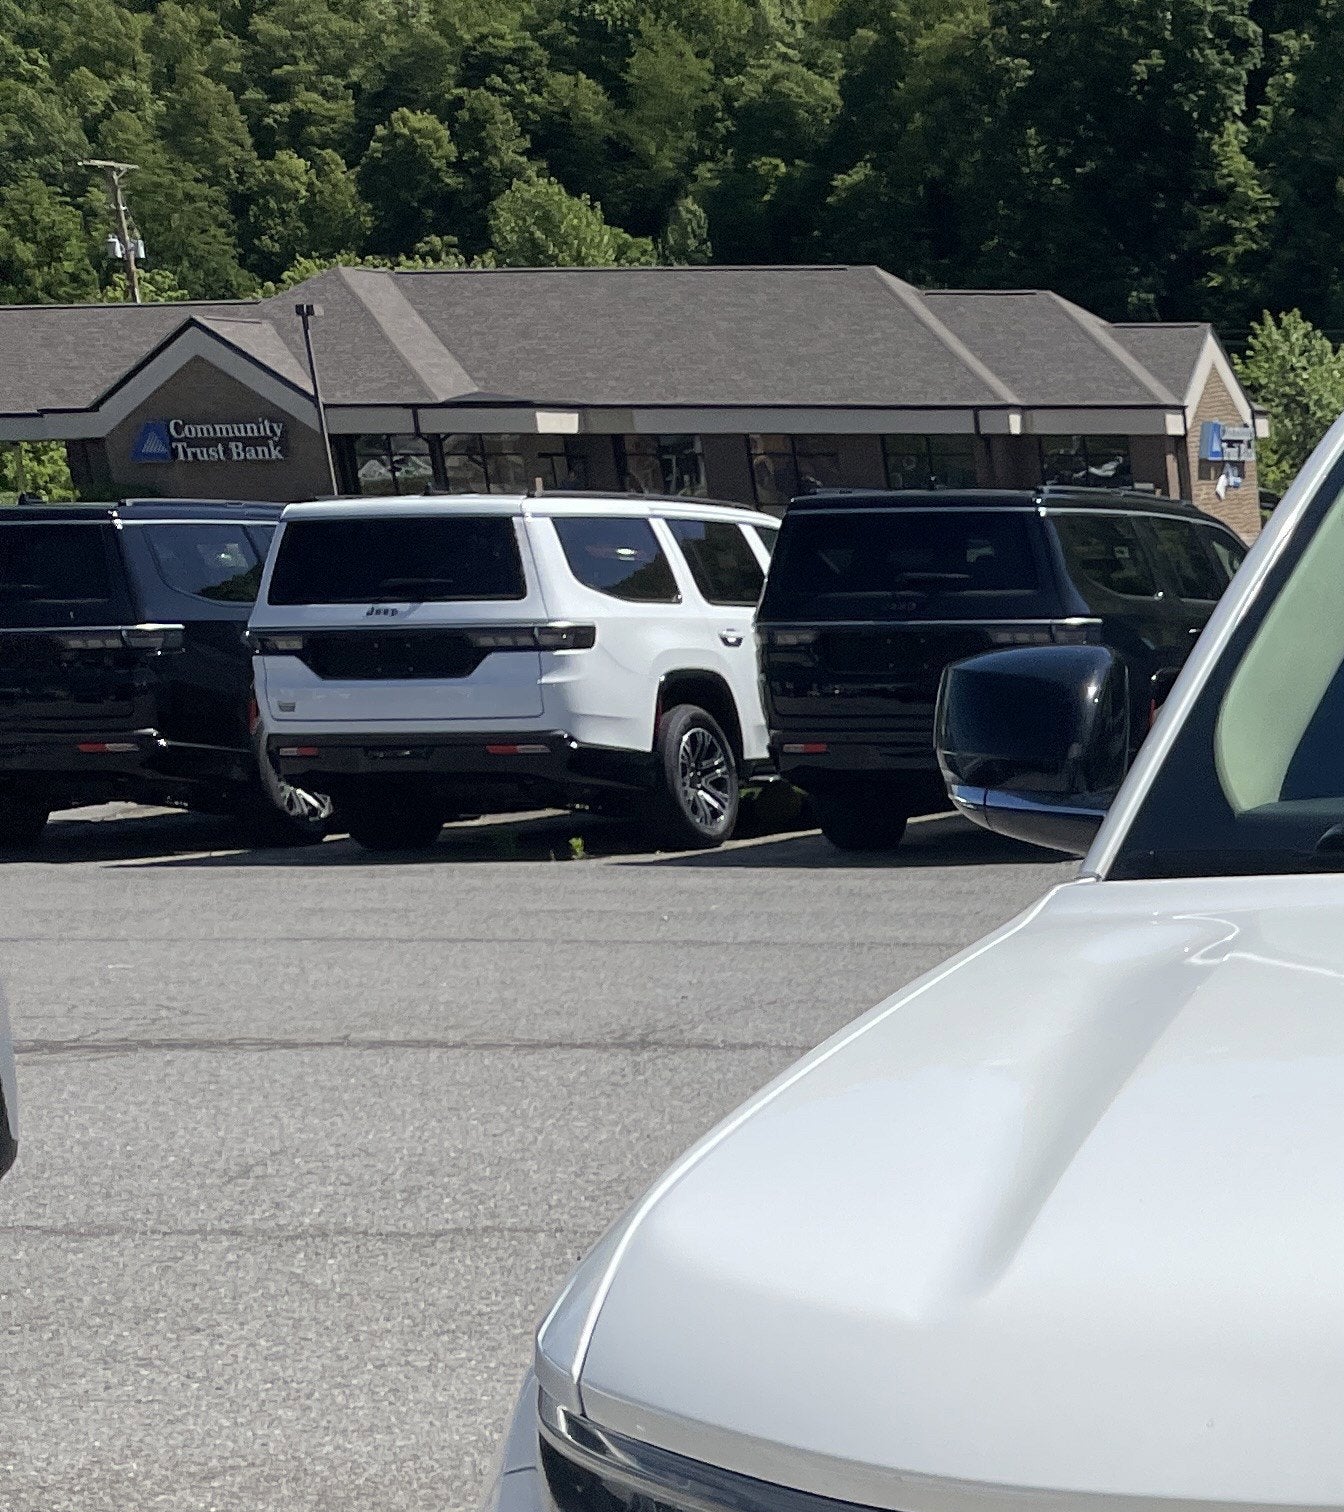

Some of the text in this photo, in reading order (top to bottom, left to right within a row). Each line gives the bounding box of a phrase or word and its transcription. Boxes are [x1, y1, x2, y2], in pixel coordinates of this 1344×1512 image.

[169, 417, 283, 440] Community
[172, 440, 284, 461] Trust Bank
